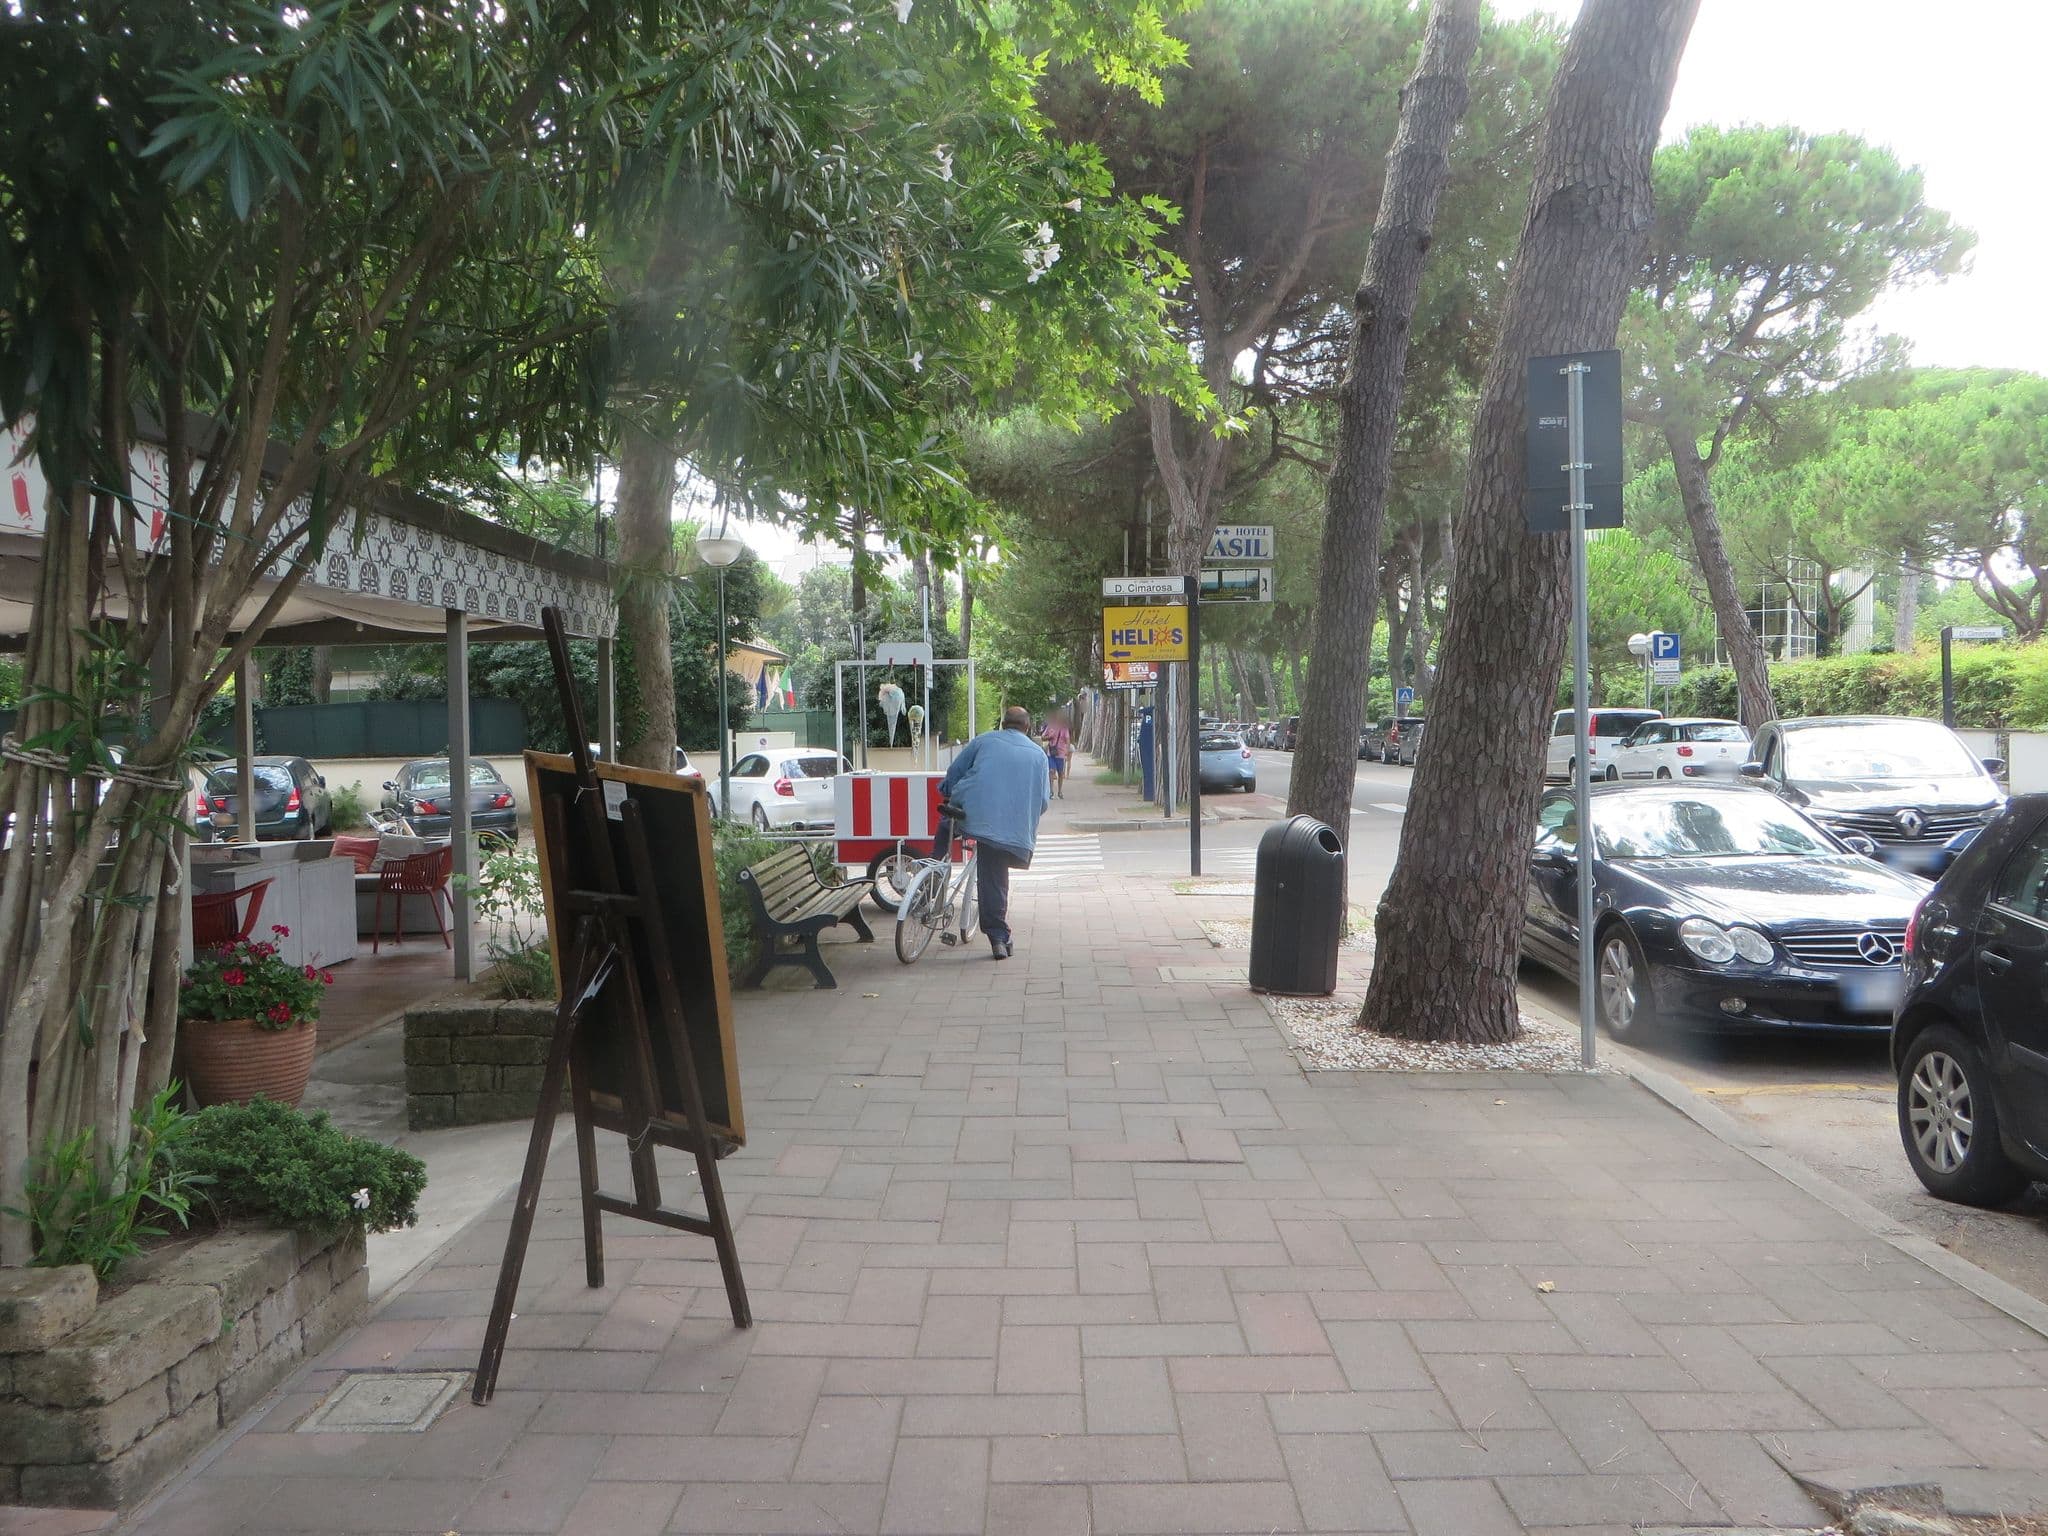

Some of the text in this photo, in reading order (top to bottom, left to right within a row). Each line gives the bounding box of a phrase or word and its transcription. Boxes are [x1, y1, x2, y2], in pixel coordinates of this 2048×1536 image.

[1236, 527, 1268, 536] HOTEL
[1204, 538, 1268, 557] ASIL
[1115, 583, 1172, 592] D. Cimarosa
[1123, 609, 1171, 626] Hotel
[1658, 636, 1674, 656] P
